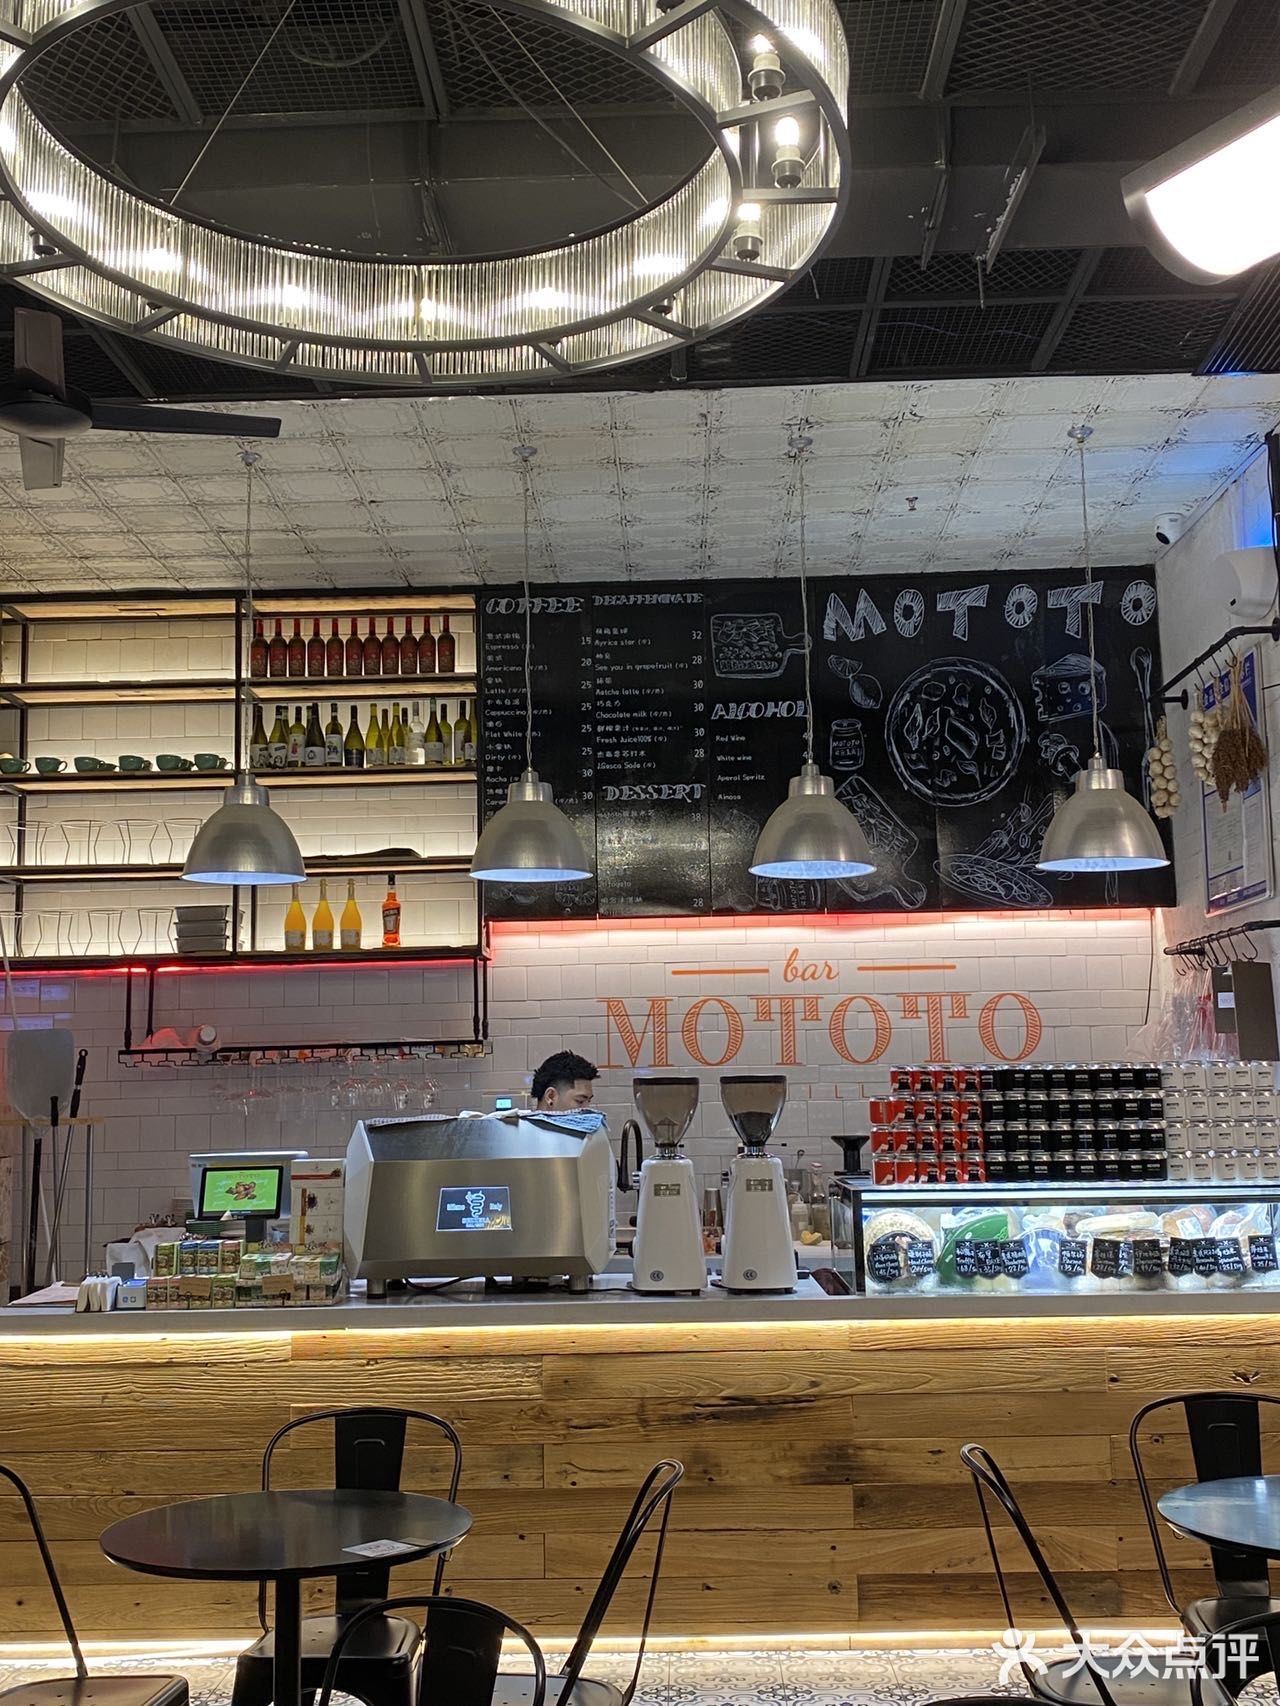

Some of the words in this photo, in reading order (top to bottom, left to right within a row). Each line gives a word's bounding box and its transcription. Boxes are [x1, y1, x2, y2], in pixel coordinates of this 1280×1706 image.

[486, 597, 584, 614] COFFEE
[823, 580, 1156, 641] MOTOTO
[691, 630, 702, 639] 32
[581, 636, 592, 645] 15
[581, 658, 592, 667] 20
[691, 655, 702, 664] 28
[610, 664, 624, 672] you
[581, 680, 592, 689] 25
[692, 680, 704, 689] 30
[581, 702, 592, 711] 25
[693, 702, 704, 712] 30
[595, 711, 631, 719] Chocolate
[581, 724, 592, 733] 25
[694, 728, 705, 737] 30
[581, 747, 593, 755] 25
[694, 748, 705, 758] 28
[582, 769, 593, 777] 30
[582, 791, 593, 800] 30
[602, 783, 707, 803] DESSERT
[692, 898, 704, 908] 28
[783, 947, 839, 983] bar
[596, 992, 1042, 1068] MOTOTO
